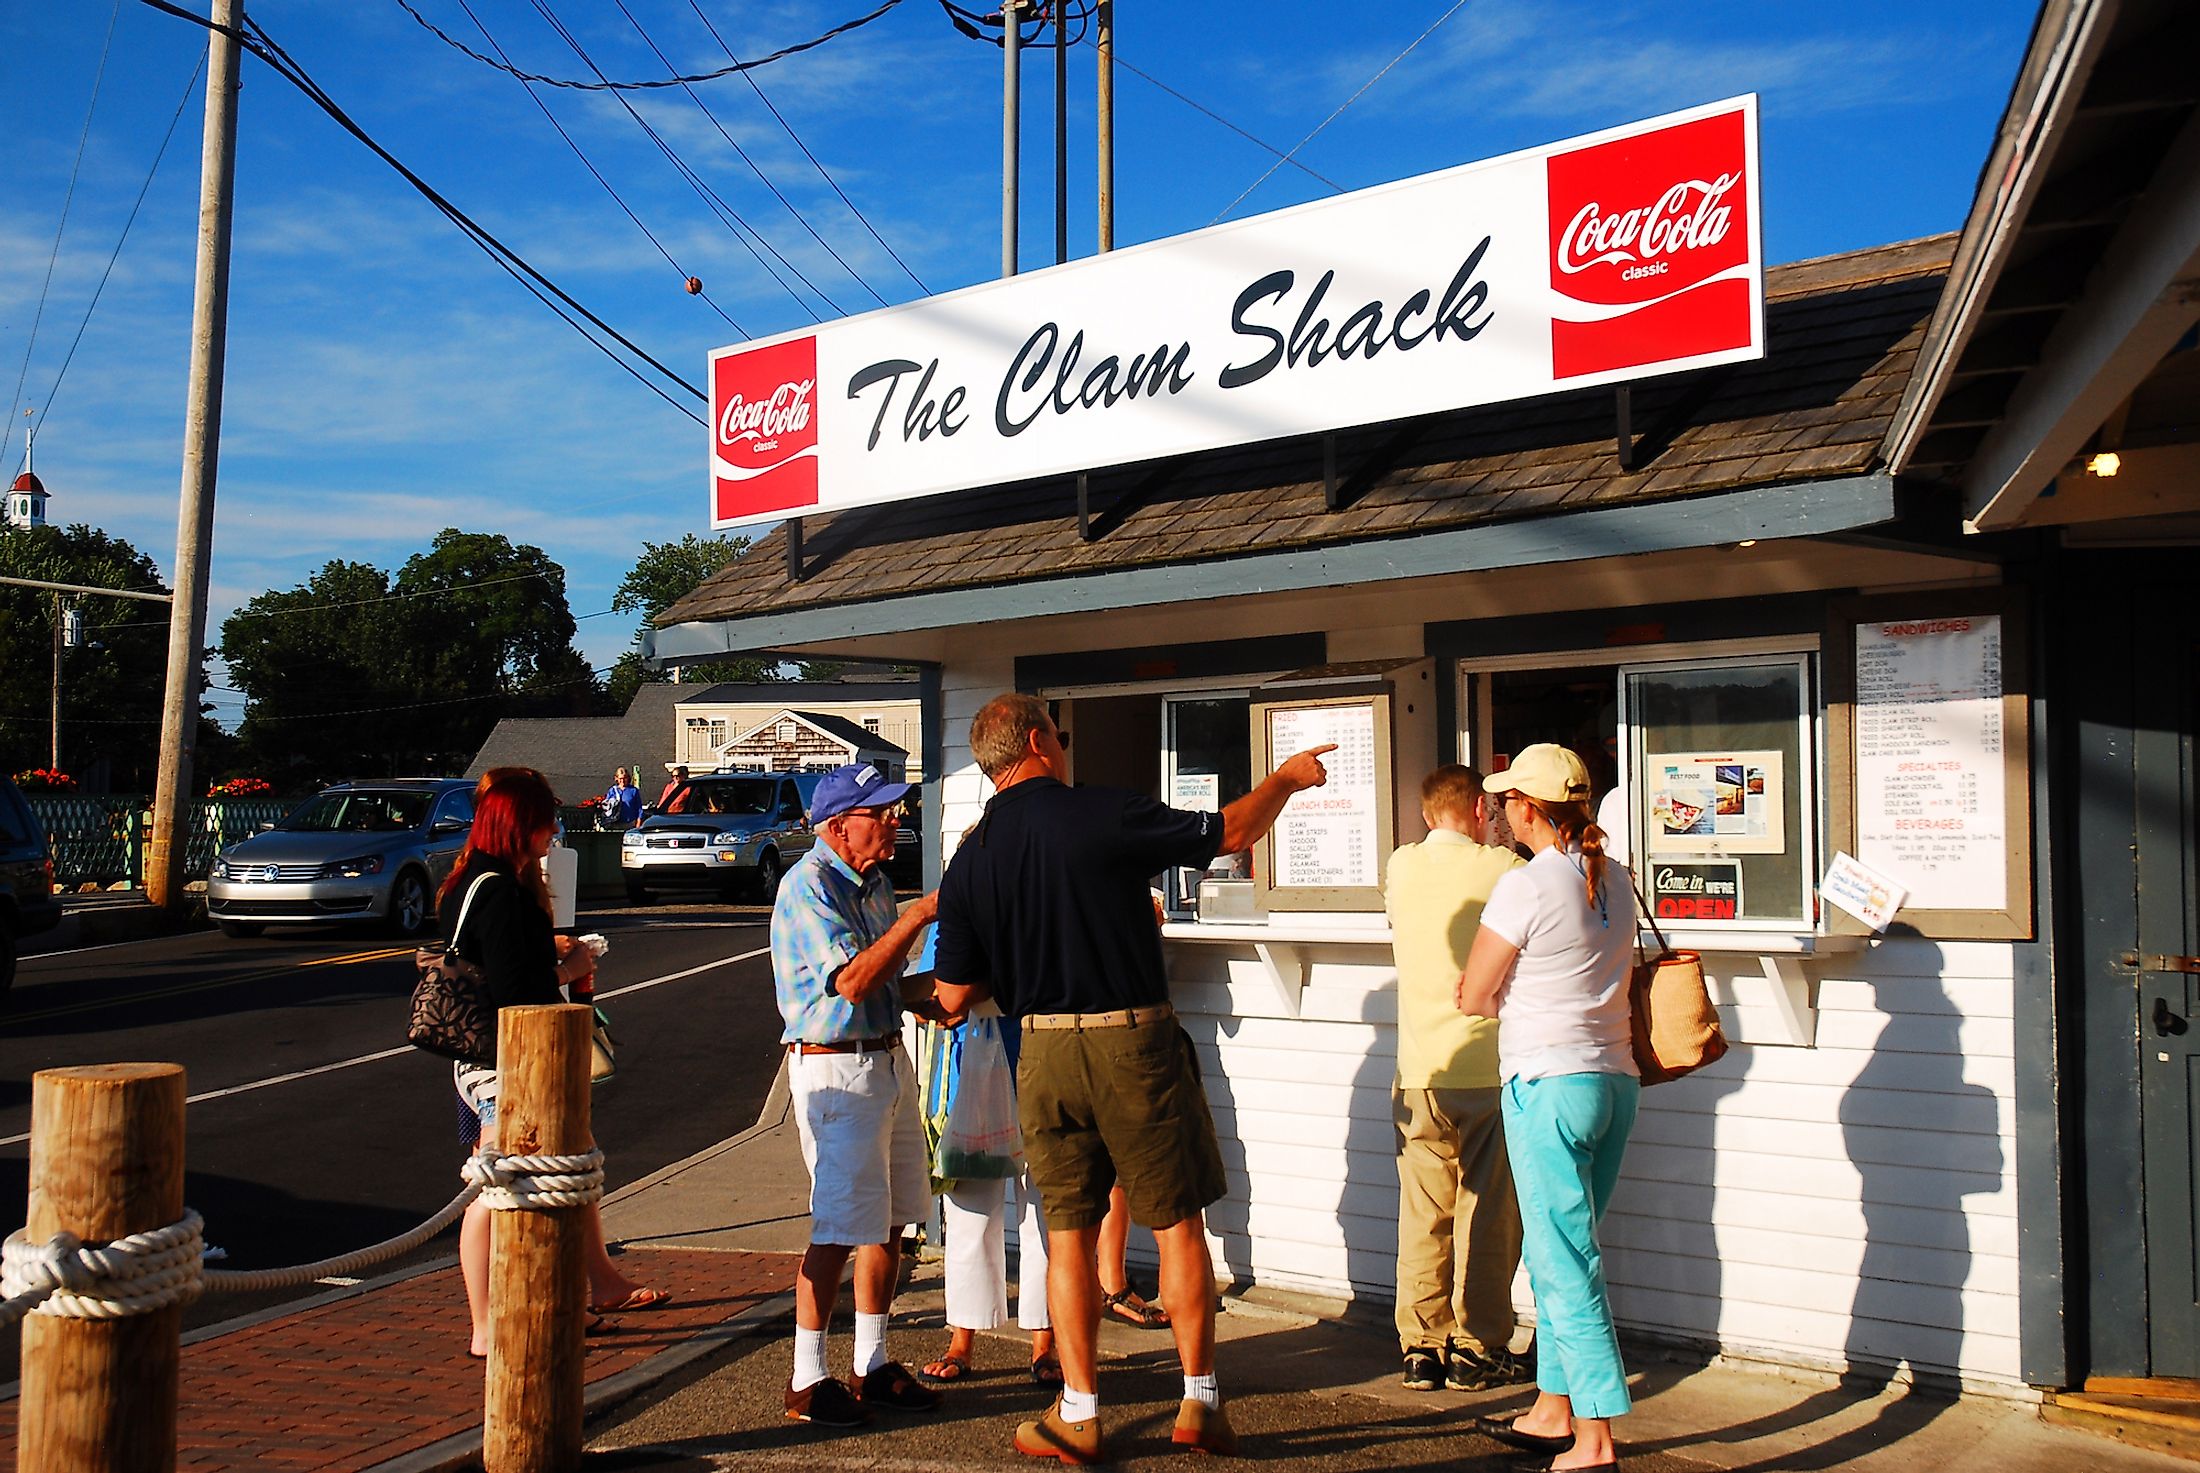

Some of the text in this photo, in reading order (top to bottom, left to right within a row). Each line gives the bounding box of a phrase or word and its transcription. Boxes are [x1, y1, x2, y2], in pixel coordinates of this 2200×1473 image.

[1557, 169, 1743, 274] Coca-Cola
[1621, 261, 1669, 283] classic
[847, 234, 1495, 451] The Clam Shack
[719, 377, 816, 445] Coca-Cola
[752, 439, 779, 453] classic
[1882, 620, 1971, 636] SANDWICHES
[1274, 712, 1298, 722] FRIED
[1897, 761, 1962, 772] SPECIALTIES
[1292, 798, 1352, 811] LUNCH BOXES
[1896, 818, 1964, 830] BEVERAGES
[1656, 867, 1735, 894] Come in WE'RE
[1658, 898, 1735, 918] OPEN
